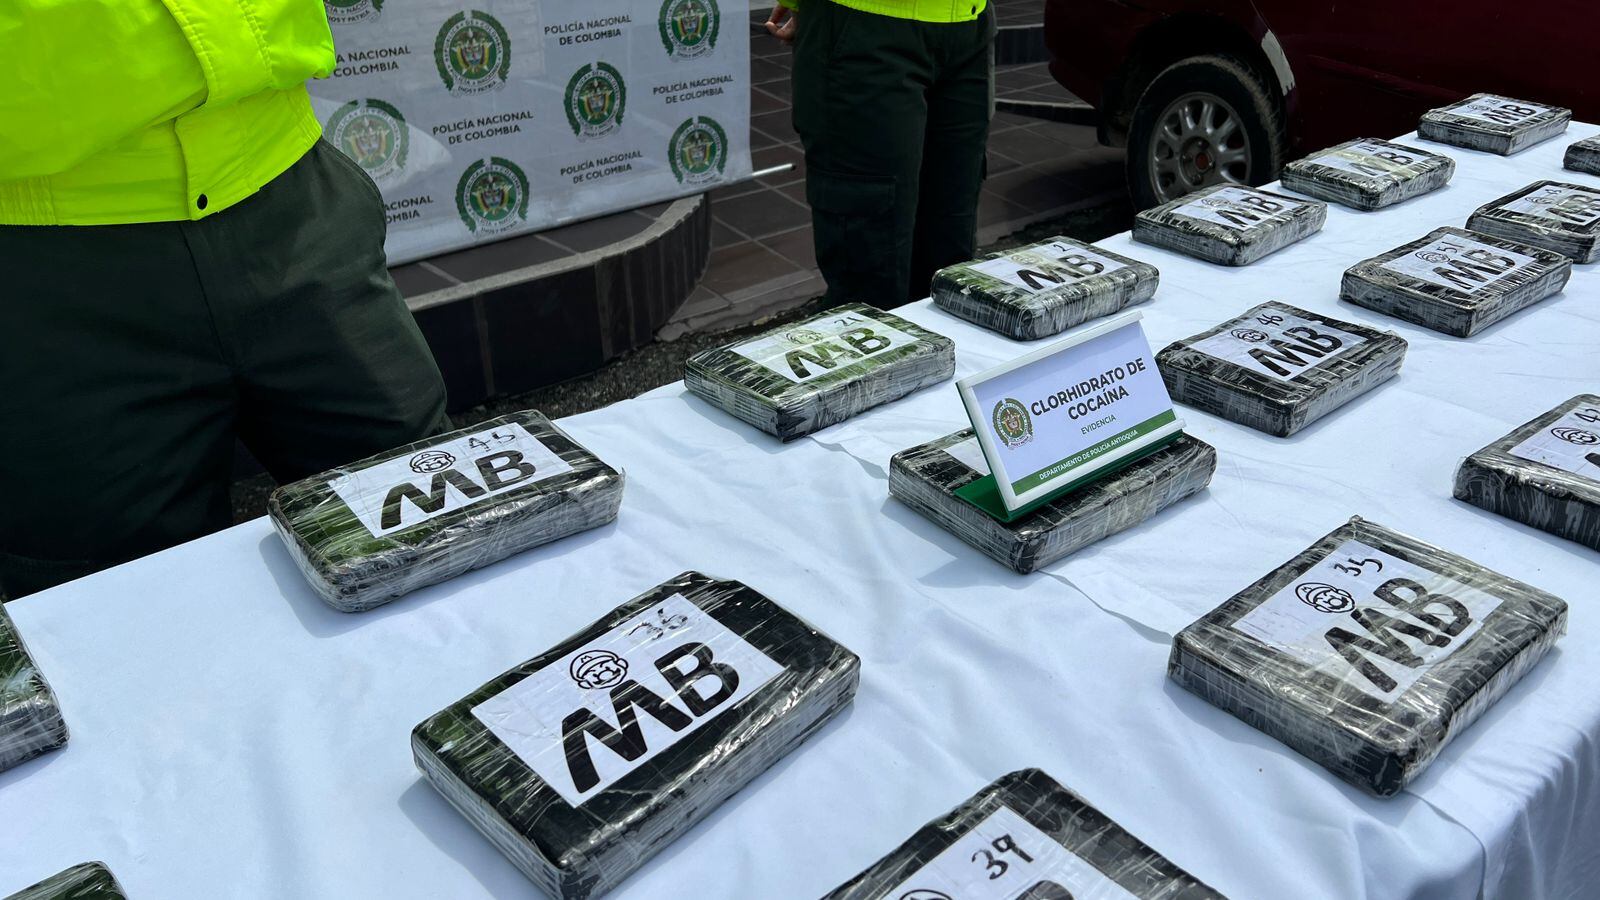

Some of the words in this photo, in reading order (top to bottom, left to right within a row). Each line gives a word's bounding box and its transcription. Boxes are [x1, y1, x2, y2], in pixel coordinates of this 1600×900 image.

[544, 21, 585, 36] POLICÍA
[586, 14, 632, 30] NACIONAL
[559, 35, 573, 46] DE
[575, 28, 622, 44] COLOMBIA
[349, 45, 412, 63] NACIONAL
[333, 60, 400, 79] COLOMBIA
[653, 82, 688, 96] POLICÍA
[690, 74, 734, 89] NACIONAL
[665, 94, 678, 104] DE
[679, 87, 724, 102] COLOMBIA
[432, 118, 476, 136] POLICÍA
[477, 110, 534, 127] NACIONAL
[1481, 104, 1537, 125] MB
[448, 133, 463, 146] DE
[464, 124, 521, 142] COLOMBIA
[560, 160, 595, 176] POLICÍA
[596, 150, 644, 168] NACIONAL
[573, 173, 585, 184] DE
[586, 163, 633, 181] COLOMBIA
[384, 194, 434, 211] ACIONAL
[1215, 196, 1284, 228] MB
[386, 209, 421, 224] OMBIA
[1437, 241, 1466, 255] 51
[1016, 254, 1105, 291] MB
[1432, 249, 1517, 290] MB
[1256, 313, 1284, 327] 46
[785, 327, 892, 379] MB
[1247, 326, 1344, 377] MB
[1030, 366, 1126, 417] CLORHIDRATO
[1127, 357, 1147, 378] DE
[1067, 384, 1130, 421] COCAÍNA
[1080, 413, 1117, 436] EVIDENCIA
[468, 431, 516, 452] 45
[1039, 455, 1083, 480] DEPARTAMENTO
[1082, 452, 1091, 460] DE
[1110, 429, 1139, 446] ANTIOQUIA
[381, 449, 538, 531] MB
[1333, 557, 1384, 577] 35
[1324, 577, 1474, 694] MB
[561, 641, 740, 795] MB
[971, 833, 1034, 881] 39
